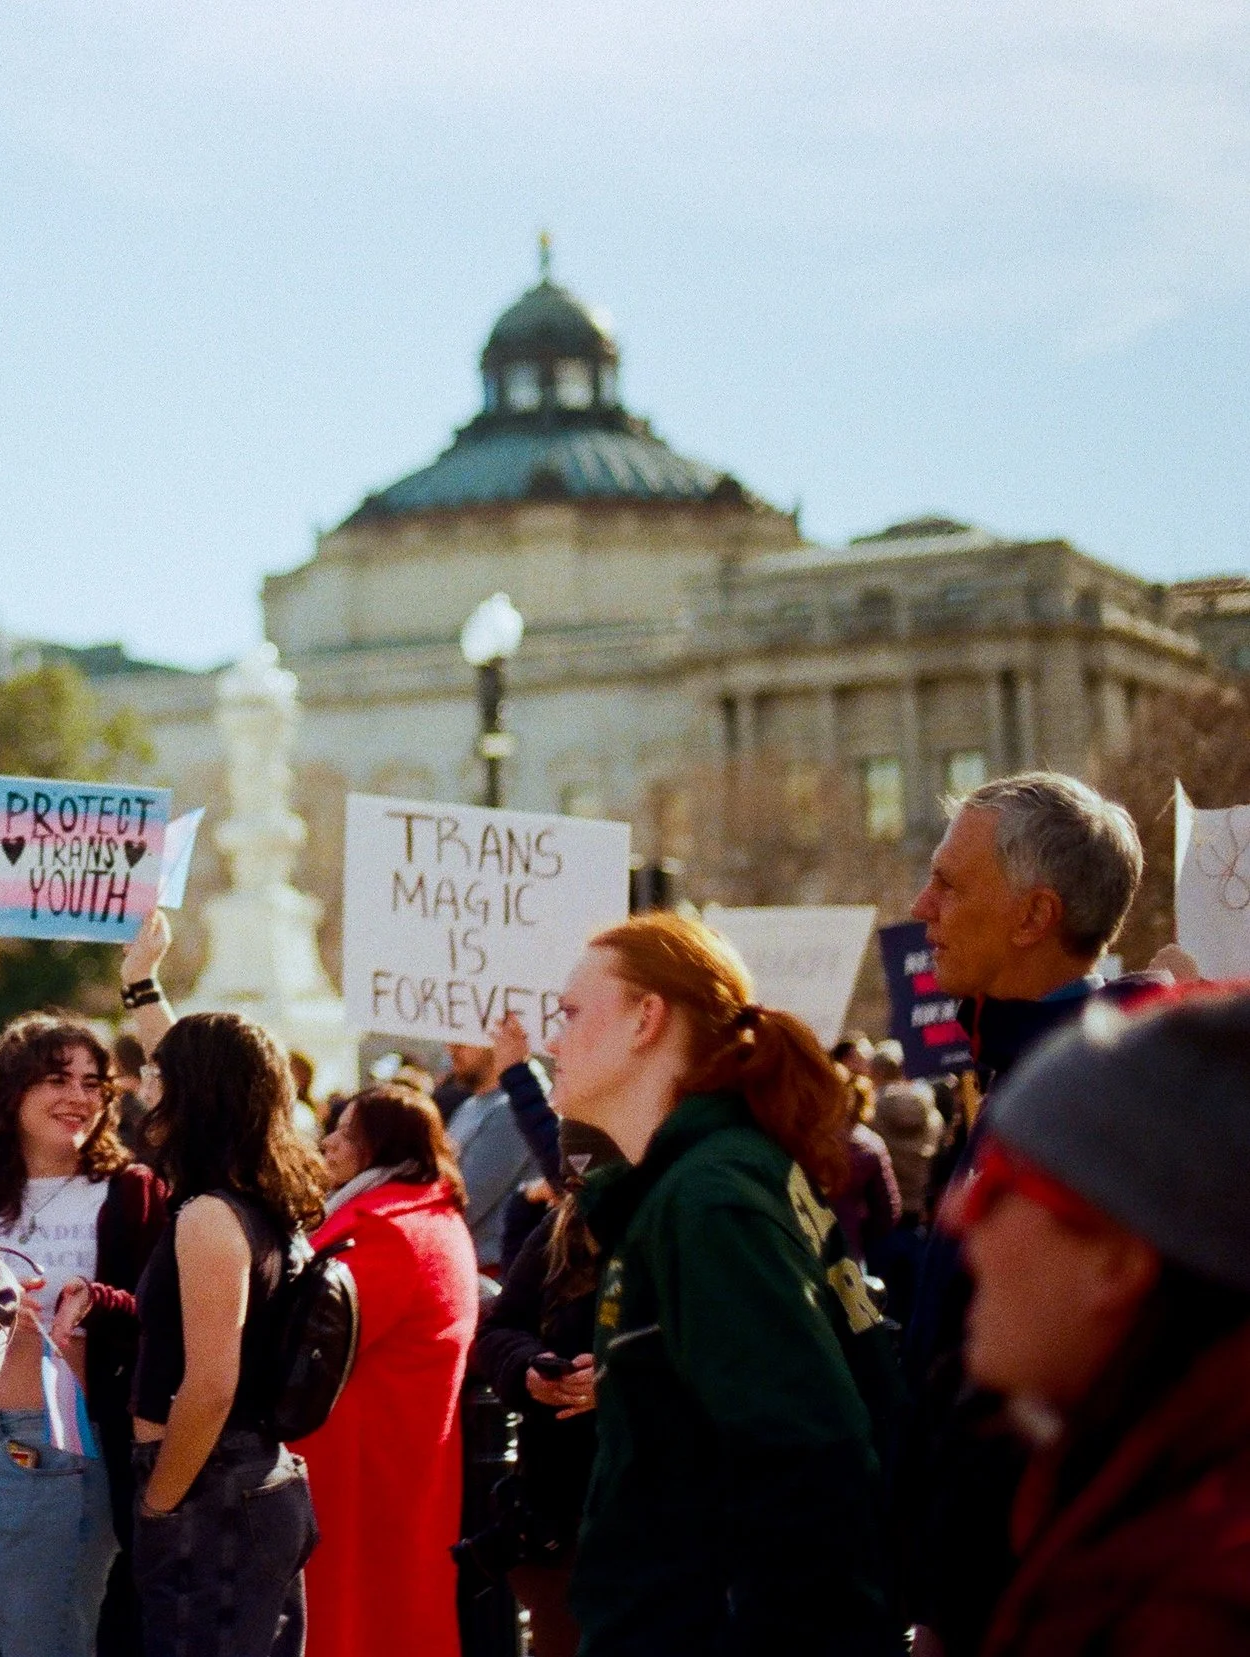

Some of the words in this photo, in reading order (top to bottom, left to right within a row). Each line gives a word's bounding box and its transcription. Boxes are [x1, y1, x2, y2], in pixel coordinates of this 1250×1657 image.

[5, 790, 155, 836] PROTECT
[31, 833, 119, 869] TRANS
[384, 809, 564, 880] TRANS
[28, 867, 132, 924] YOUTH
[391, 869, 539, 926] MAGIC
[448, 926, 488, 975] IS
